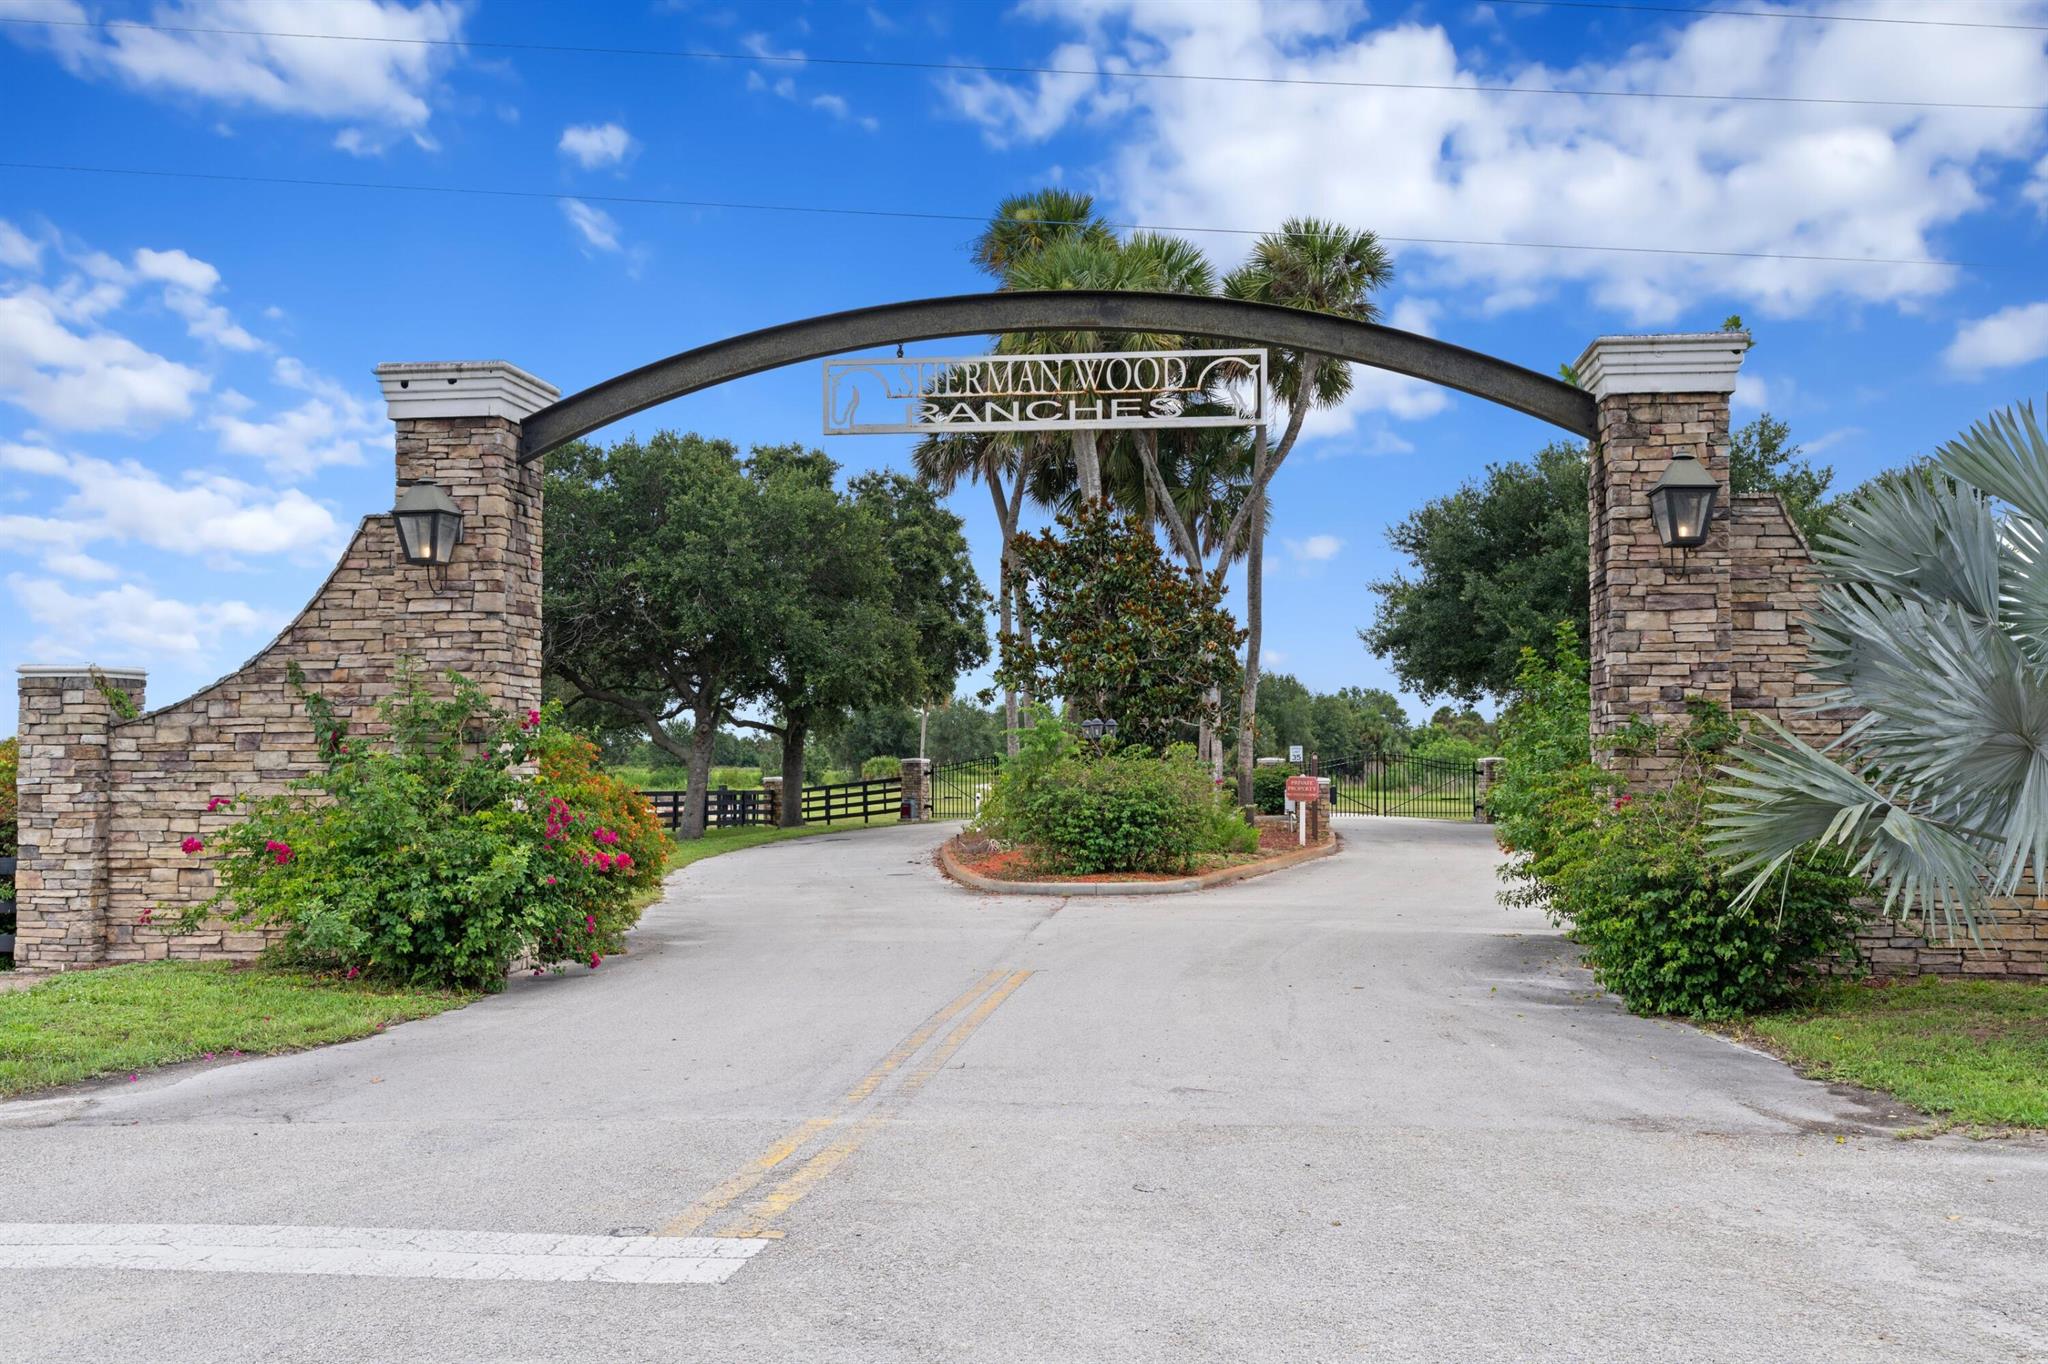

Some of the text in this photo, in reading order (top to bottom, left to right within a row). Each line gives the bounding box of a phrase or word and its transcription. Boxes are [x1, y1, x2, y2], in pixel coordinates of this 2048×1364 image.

[896, 356, 1187, 397] SHERMAN WOOD
[906, 398, 1185, 426] RANCHES
